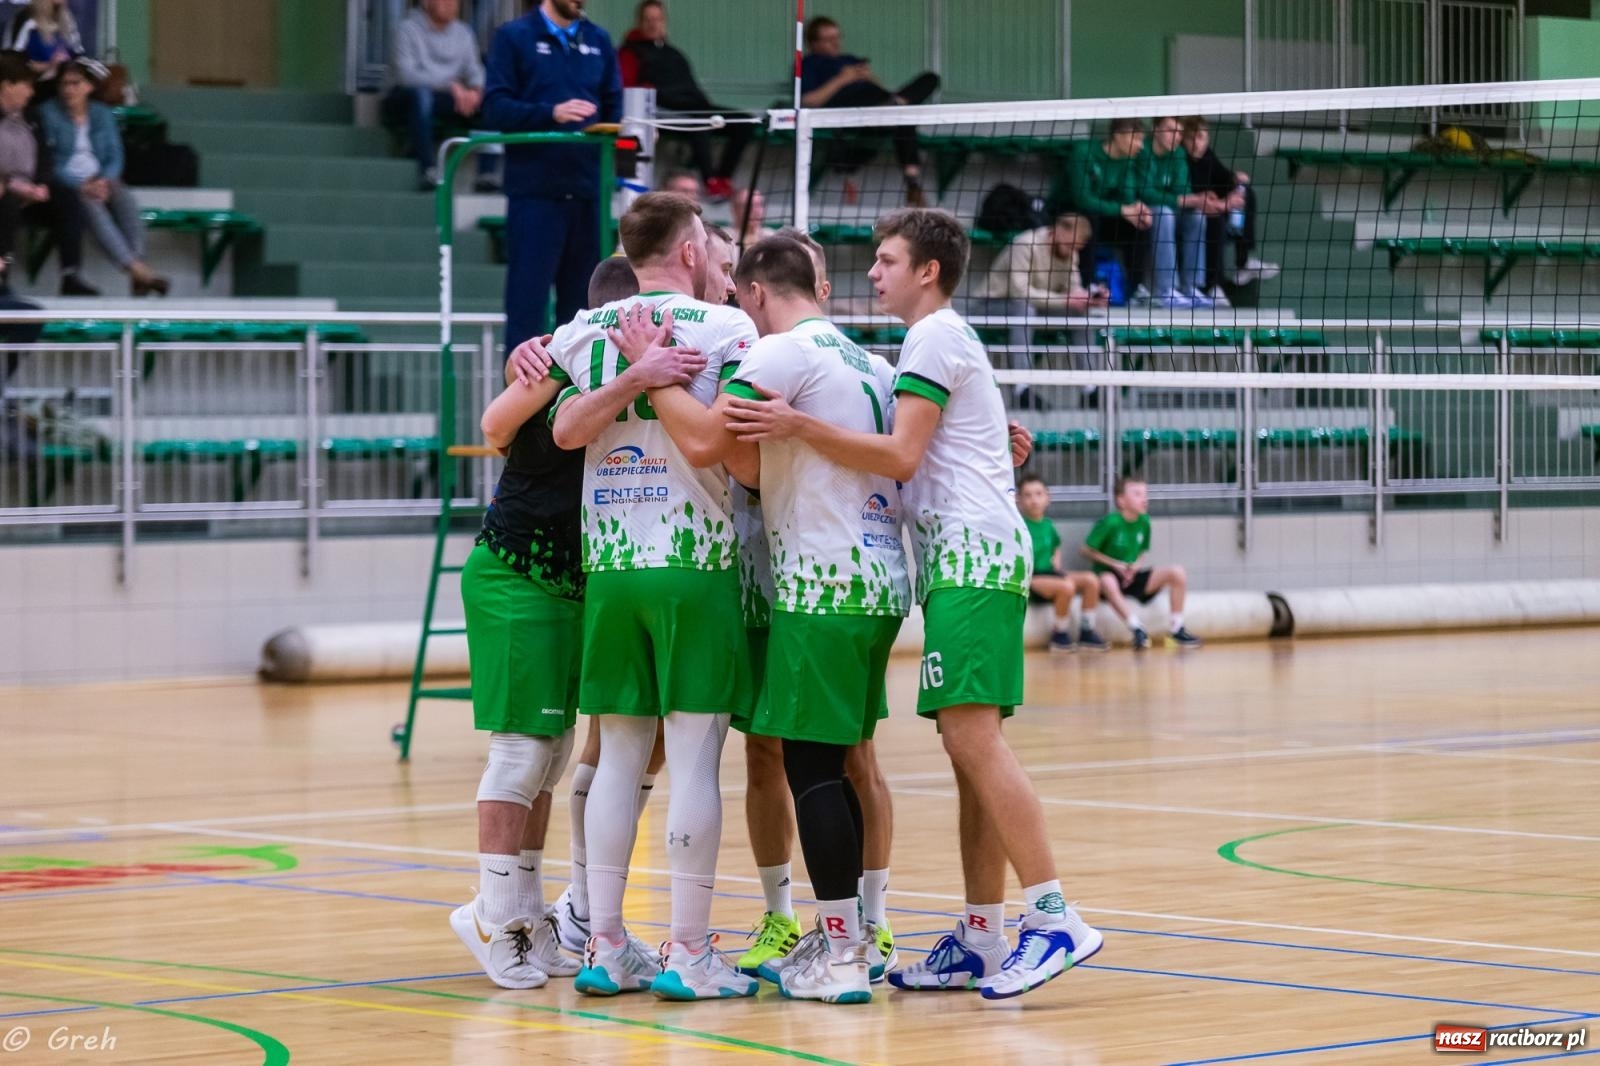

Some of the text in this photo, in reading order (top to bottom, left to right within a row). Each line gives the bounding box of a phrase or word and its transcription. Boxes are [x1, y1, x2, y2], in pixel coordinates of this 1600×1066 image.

[639, 458, 667, 466] MULTI
[825, 916, 847, 934] R
[969, 914, 988, 928] R
